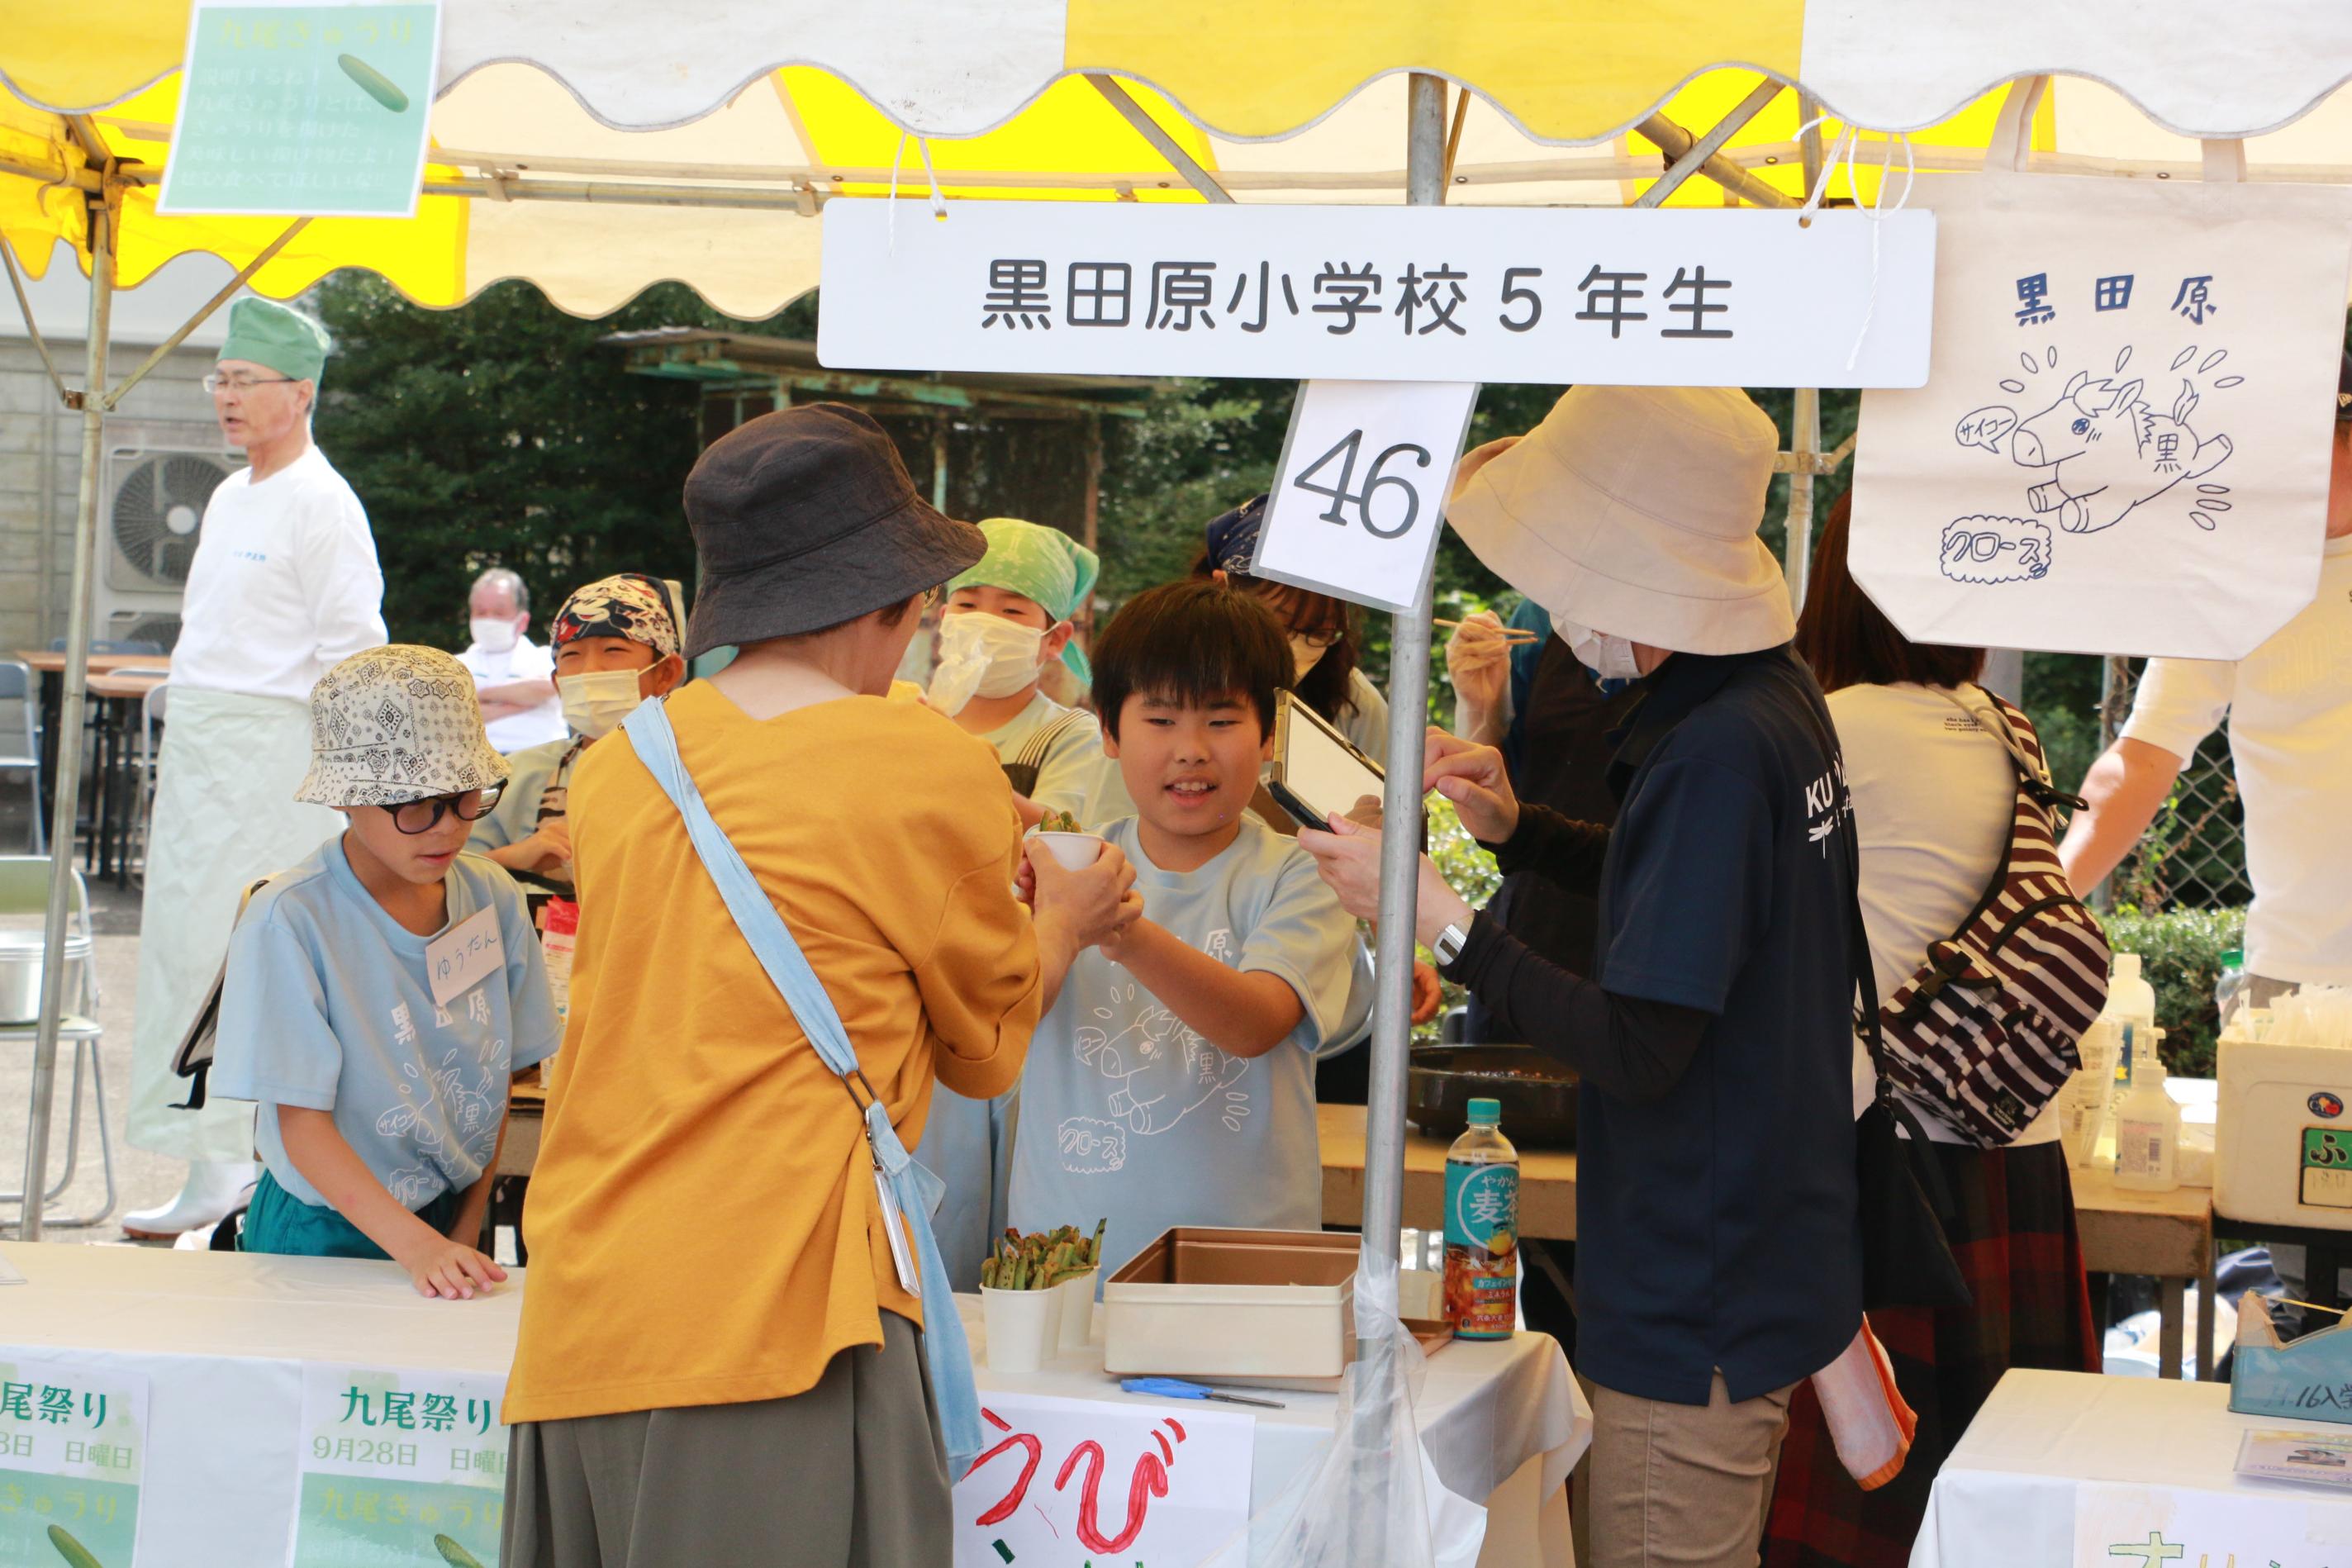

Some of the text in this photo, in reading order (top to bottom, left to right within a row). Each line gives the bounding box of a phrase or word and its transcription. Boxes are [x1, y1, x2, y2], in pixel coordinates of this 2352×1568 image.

[981, 259, 1734, 340] 黒田原小学校5年生
[2015, 273, 2217, 326] 黒田原
[1960, 418, 2012, 443] サイコー
[2154, 434, 2182, 473] 黒
[1293, 427, 1432, 539] 46
[1199, 1052, 1215, 1084] 黒
[463, 1105, 480, 1132] 黒
[1469, 1190, 1519, 1224] 麦茶
[0, 1381, 107, 1429] 尾祭り
[340, 1385, 492, 1436] 九尾祭り
[65, 1441, 133, 1469] 日曜日
[312, 1435, 418, 1466] 9月28日
